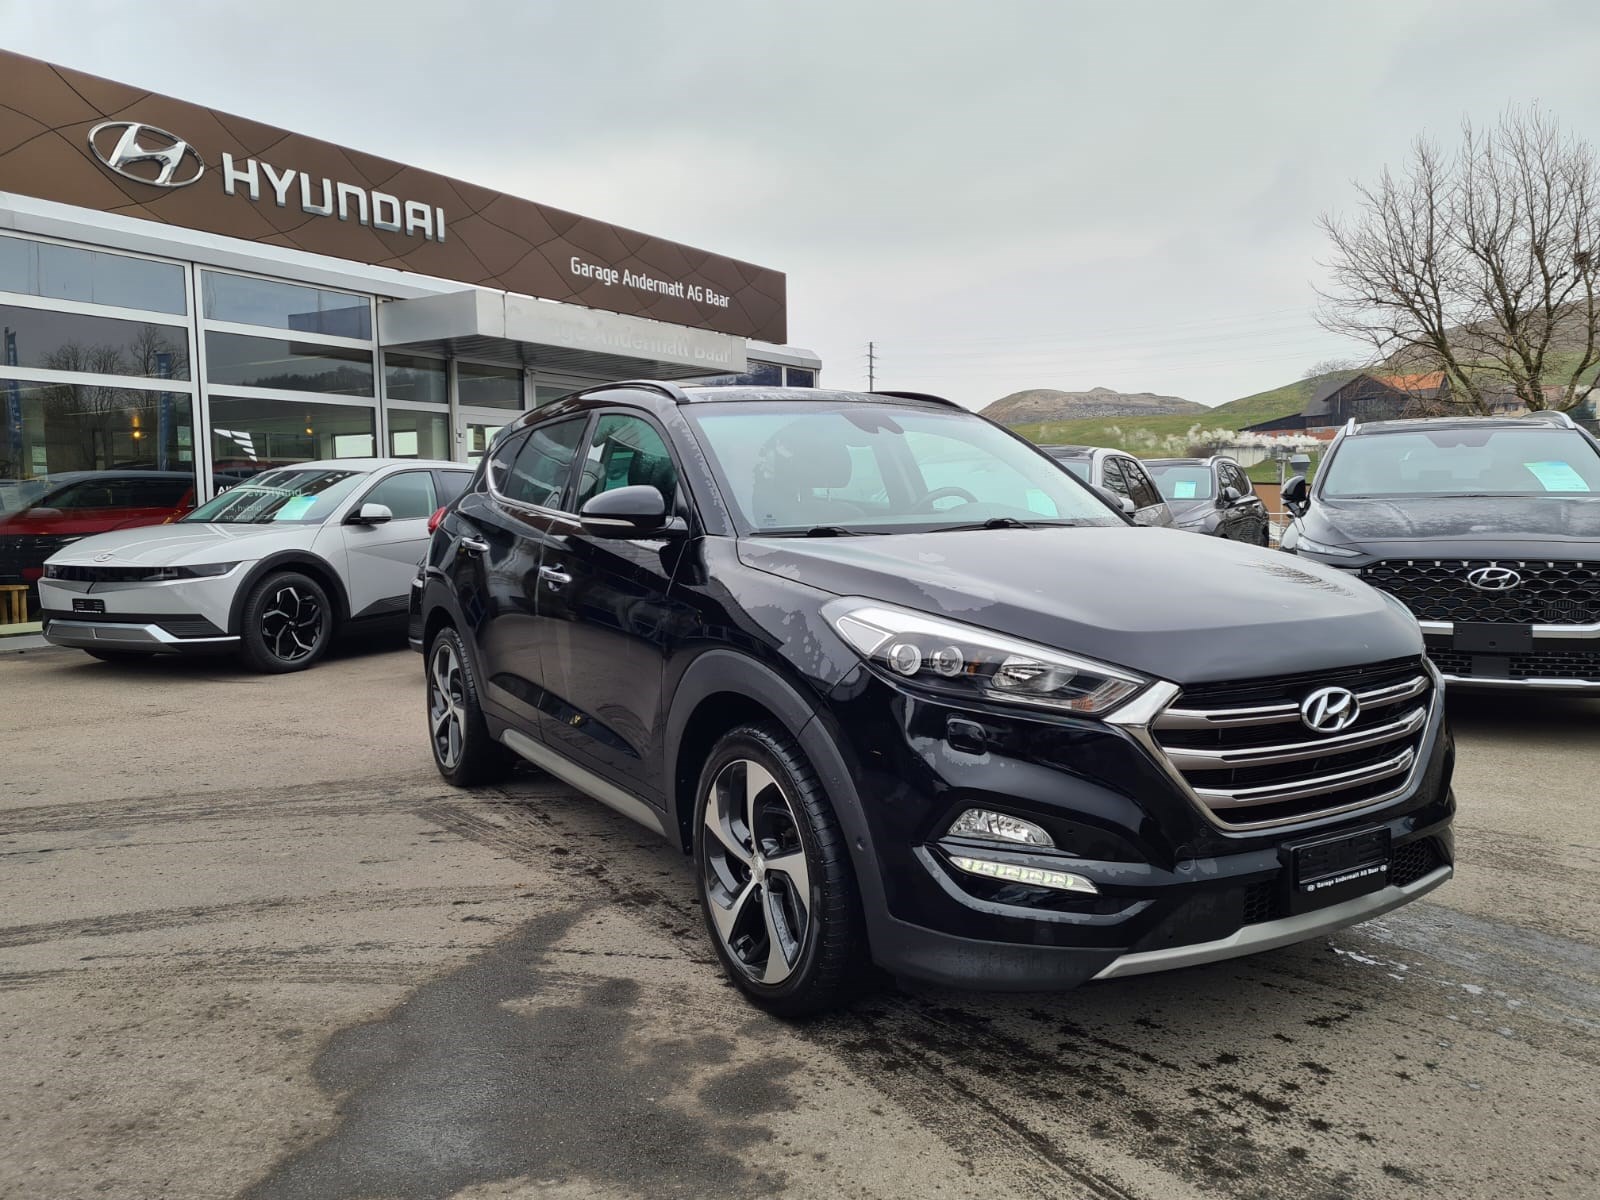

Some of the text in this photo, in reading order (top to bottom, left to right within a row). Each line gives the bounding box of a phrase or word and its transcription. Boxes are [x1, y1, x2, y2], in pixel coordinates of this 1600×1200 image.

[221, 152, 446, 243] HYUNDAI
[570, 256, 730, 308] Garage Andermatt AG Baar
